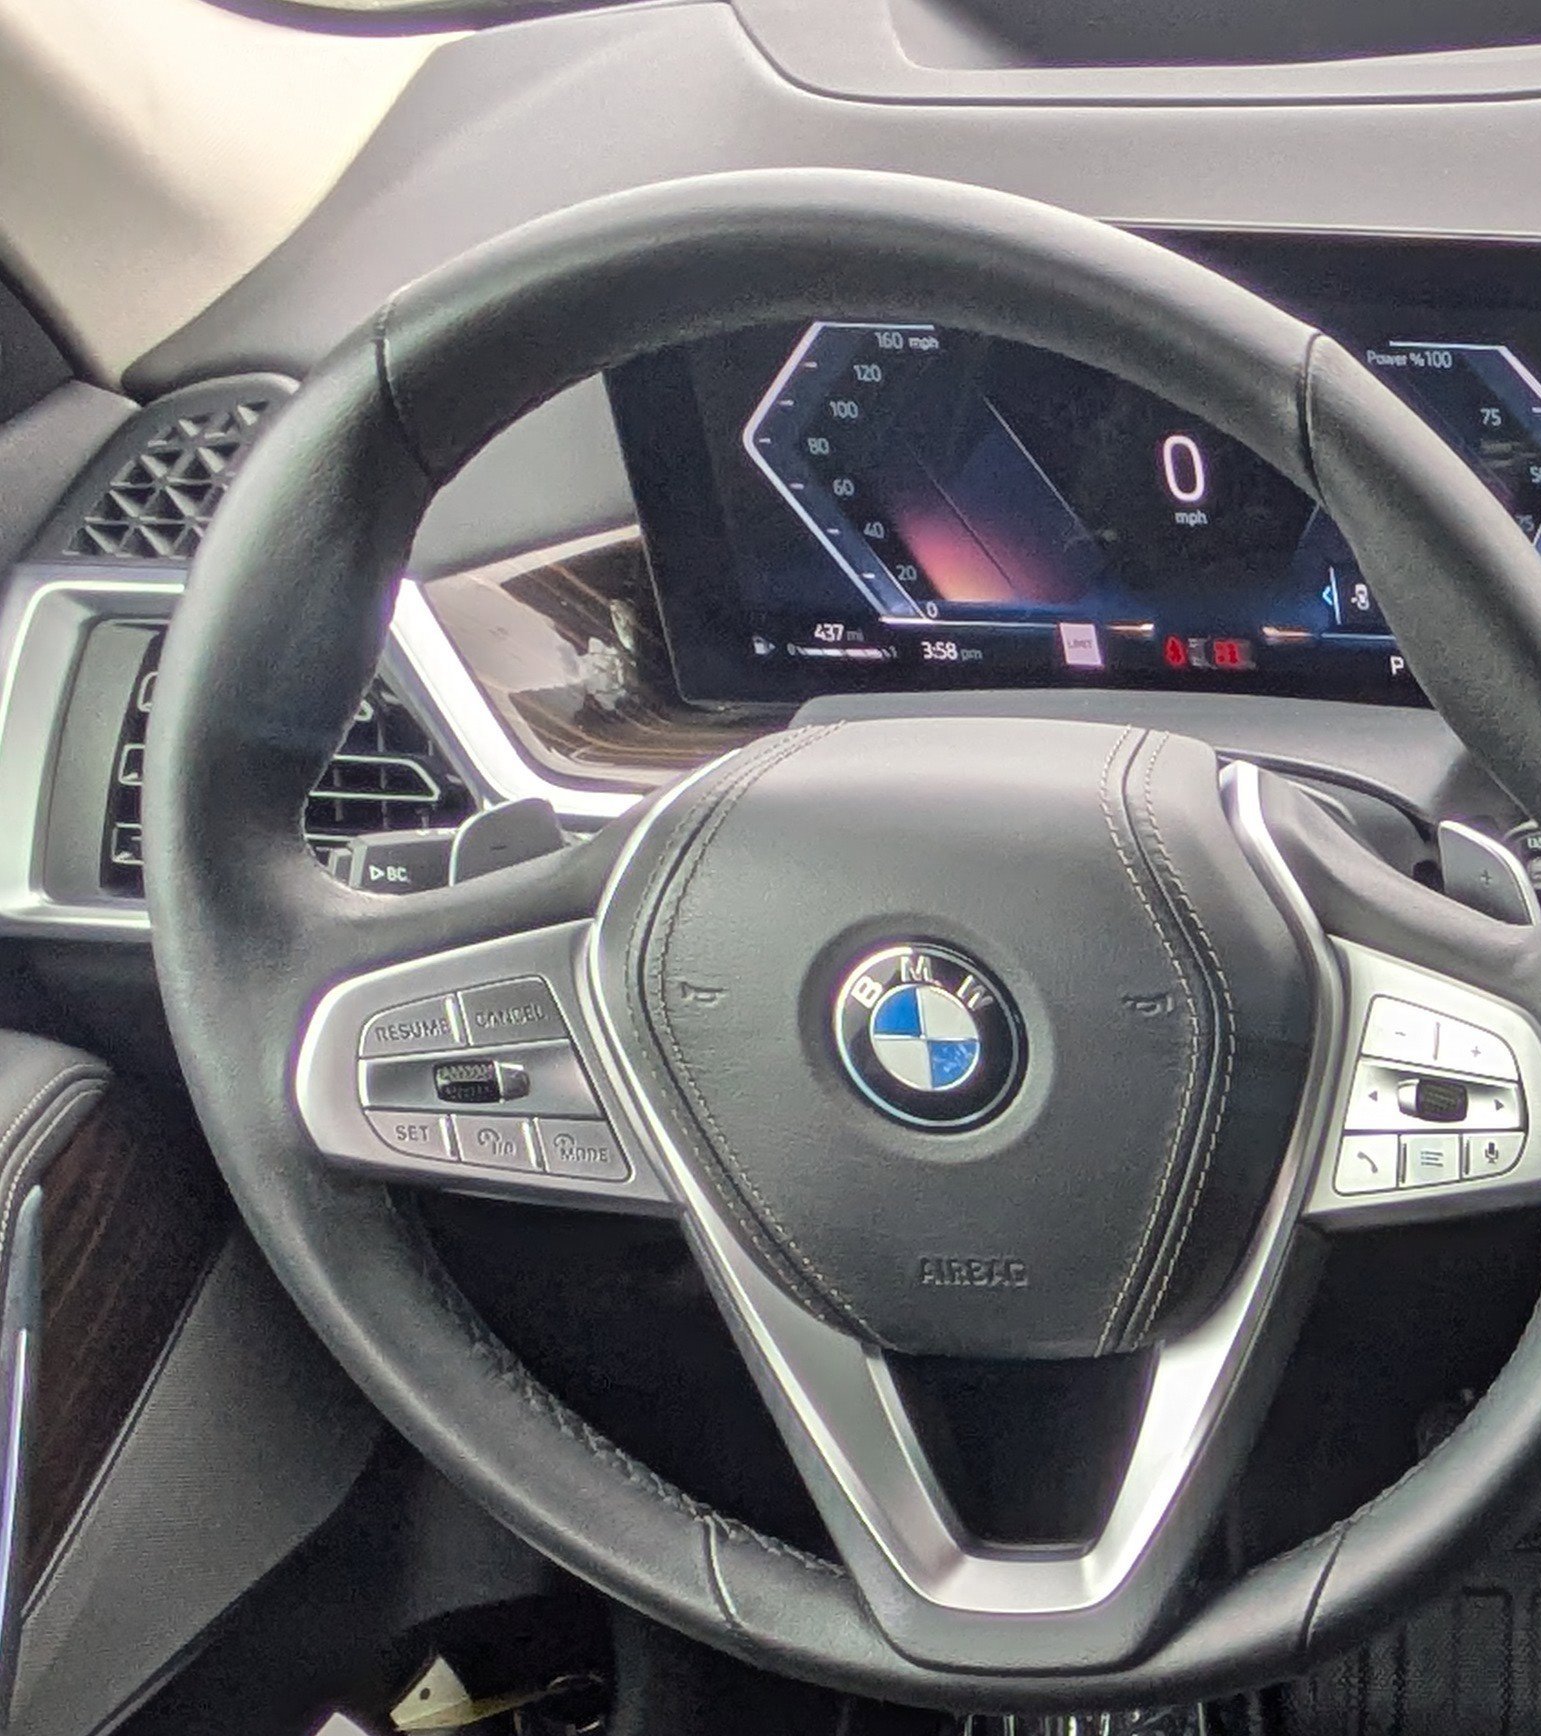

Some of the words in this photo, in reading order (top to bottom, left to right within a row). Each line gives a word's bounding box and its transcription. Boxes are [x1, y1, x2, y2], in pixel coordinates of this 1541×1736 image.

[874, 332, 903, 349] 160
[909, 336, 939, 352] mph
[1366, 350, 1408, 367] Power
[853, 364, 882, 382] 120
[829, 401, 859, 419] 100
[1480, 408, 1502, 426] 75
[808, 437, 829, 455] 80
[1163, 435, 1206, 502] 0
[833, 479, 854, 496] 60
[1174, 510, 1208, 527] mph
[863, 522, 885, 539] 40
[898, 565, 917, 581] 20
[926, 603, 938, 619] 0
[814, 623, 844, 641] 437
[921, 641, 958, 660] 3:58
[1390, 655, 1405, 675] P
[851, 956, 993, 1010] BMW
[475, 1003, 546, 1028] CANCEL
[375, 1017, 450, 1042] RESUME
[395, 1125, 430, 1142] SET
[917, 1255, 1030, 1289] AIRBAG
